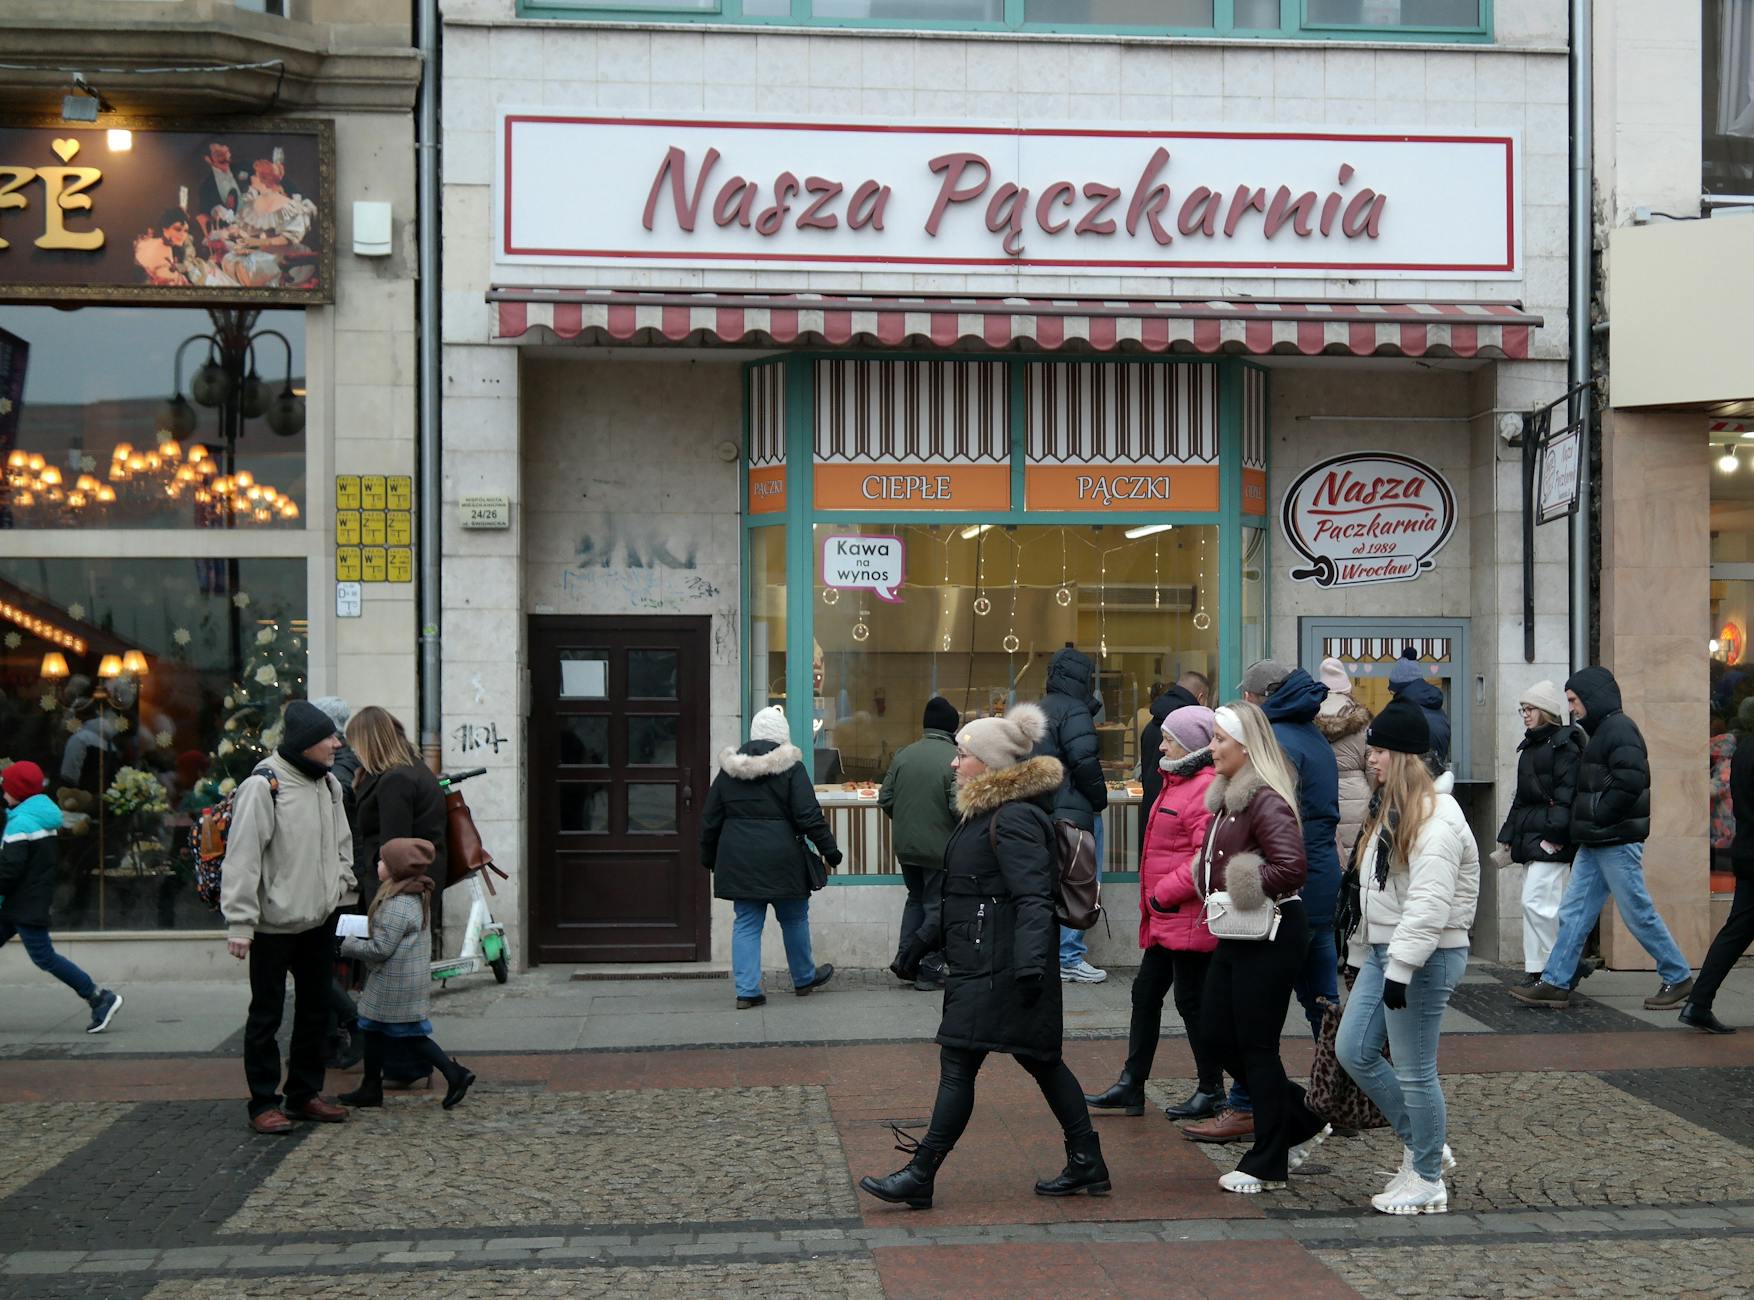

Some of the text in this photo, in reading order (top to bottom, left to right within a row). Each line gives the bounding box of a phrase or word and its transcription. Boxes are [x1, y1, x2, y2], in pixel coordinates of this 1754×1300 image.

[642, 145, 1388, 257] Nasza Pączkarnia
[753, 479, 784, 499] PĄCZKI
[861, 474, 1171, 506] CIEPŁE PĄCZKI
[1312, 470, 1427, 507] Nasza
[471, 509, 497, 519] 24/26
[1313, 512, 1438, 542] Pączkarnia
[837, 540, 889, 556] Kawa
[1352, 542, 1397, 555] od 1989
[856, 558, 870, 567] na
[1341, 559, 1413, 581] Wrocław
[837, 569, 889, 583] wynos
